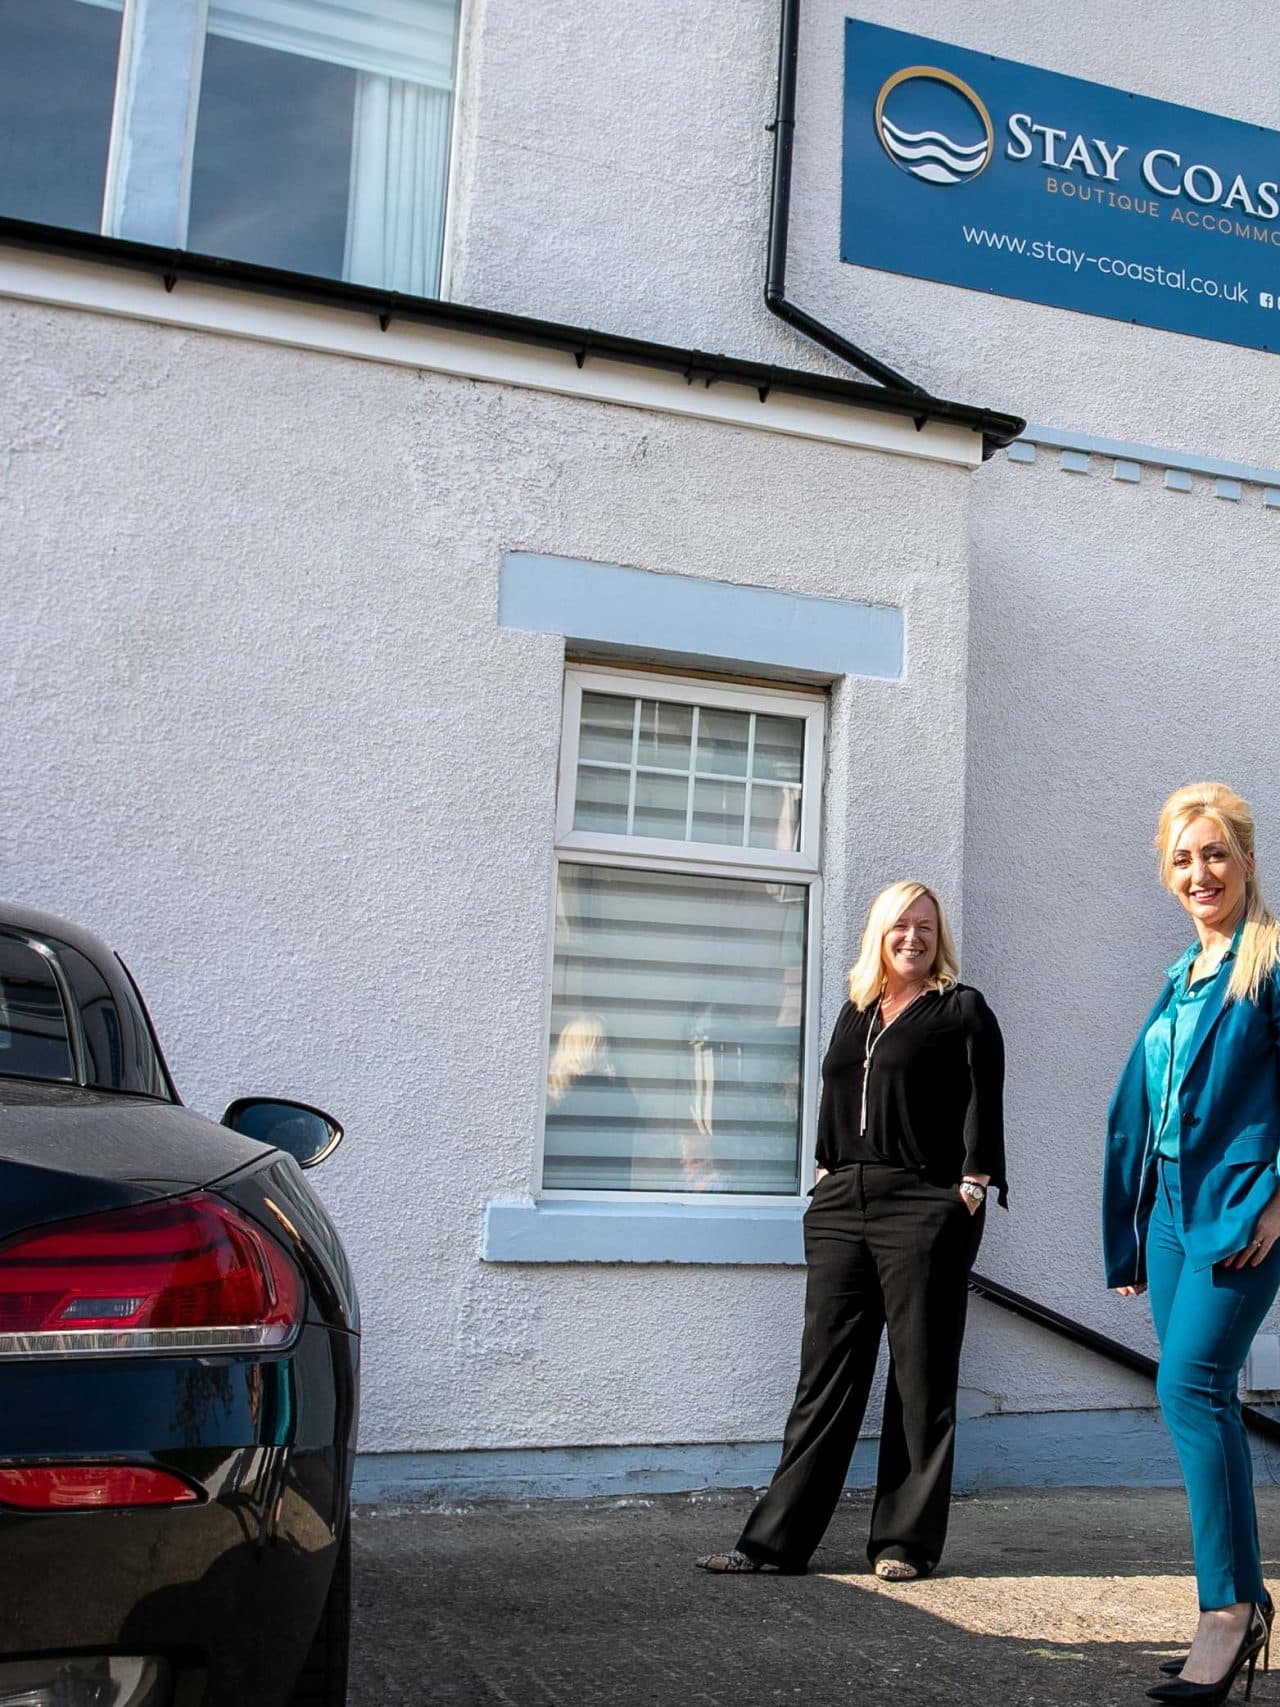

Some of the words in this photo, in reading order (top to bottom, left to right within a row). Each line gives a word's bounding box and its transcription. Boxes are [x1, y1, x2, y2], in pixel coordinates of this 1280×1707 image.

[1006, 113, 1129, 182] STAY
[1046, 177, 1160, 218] BOUTIQUE
[962, 225, 1249, 305] www.stay-coastal.co.uk
